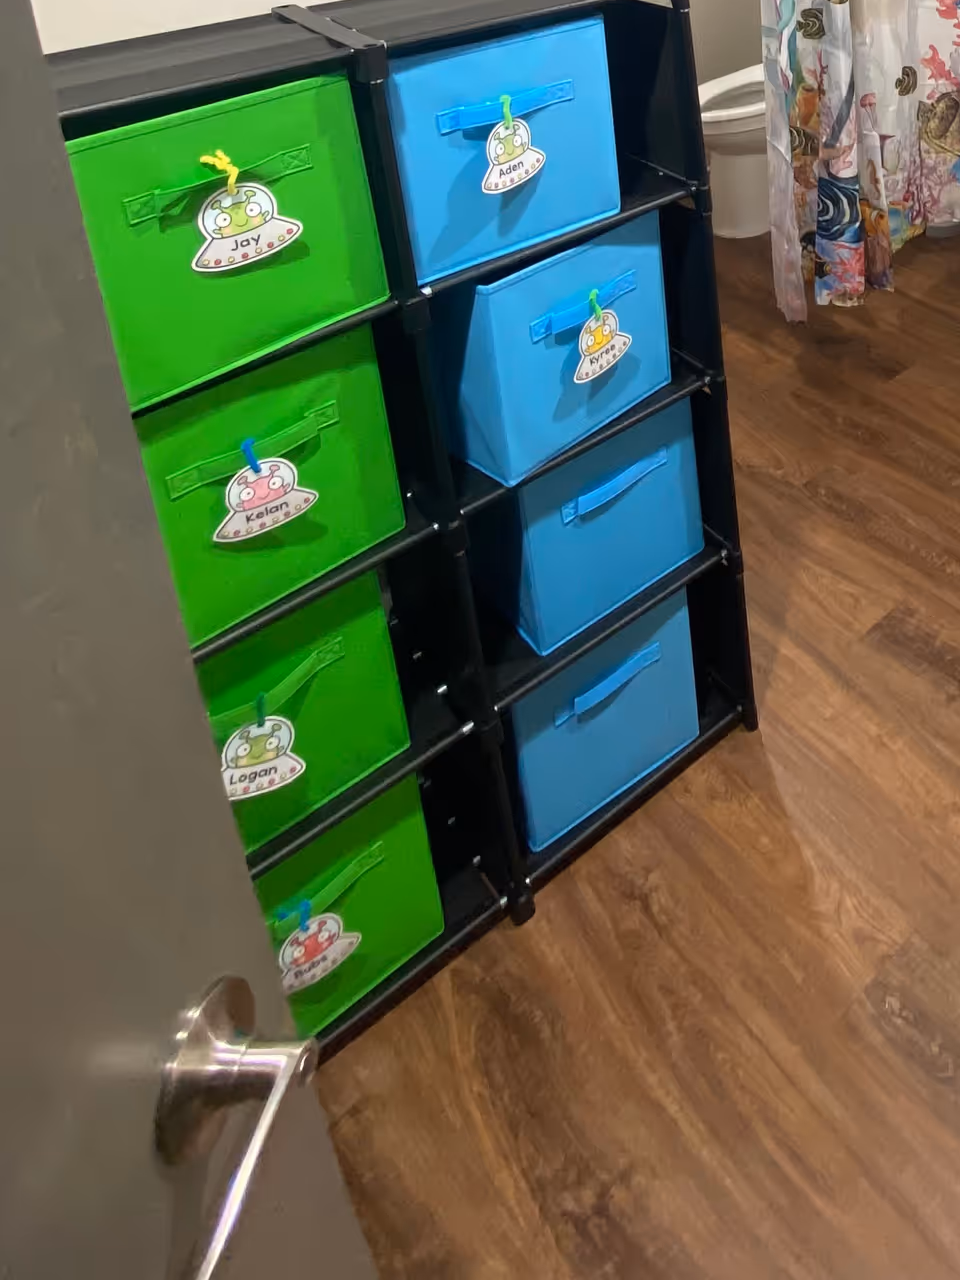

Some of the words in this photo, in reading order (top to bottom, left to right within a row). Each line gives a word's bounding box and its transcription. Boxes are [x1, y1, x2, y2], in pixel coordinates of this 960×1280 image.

[499, 160, 524, 179] Aden
[230, 234, 261, 252] Jay
[245, 501, 290, 525] Kelan
[229, 765, 278, 786] Logan
